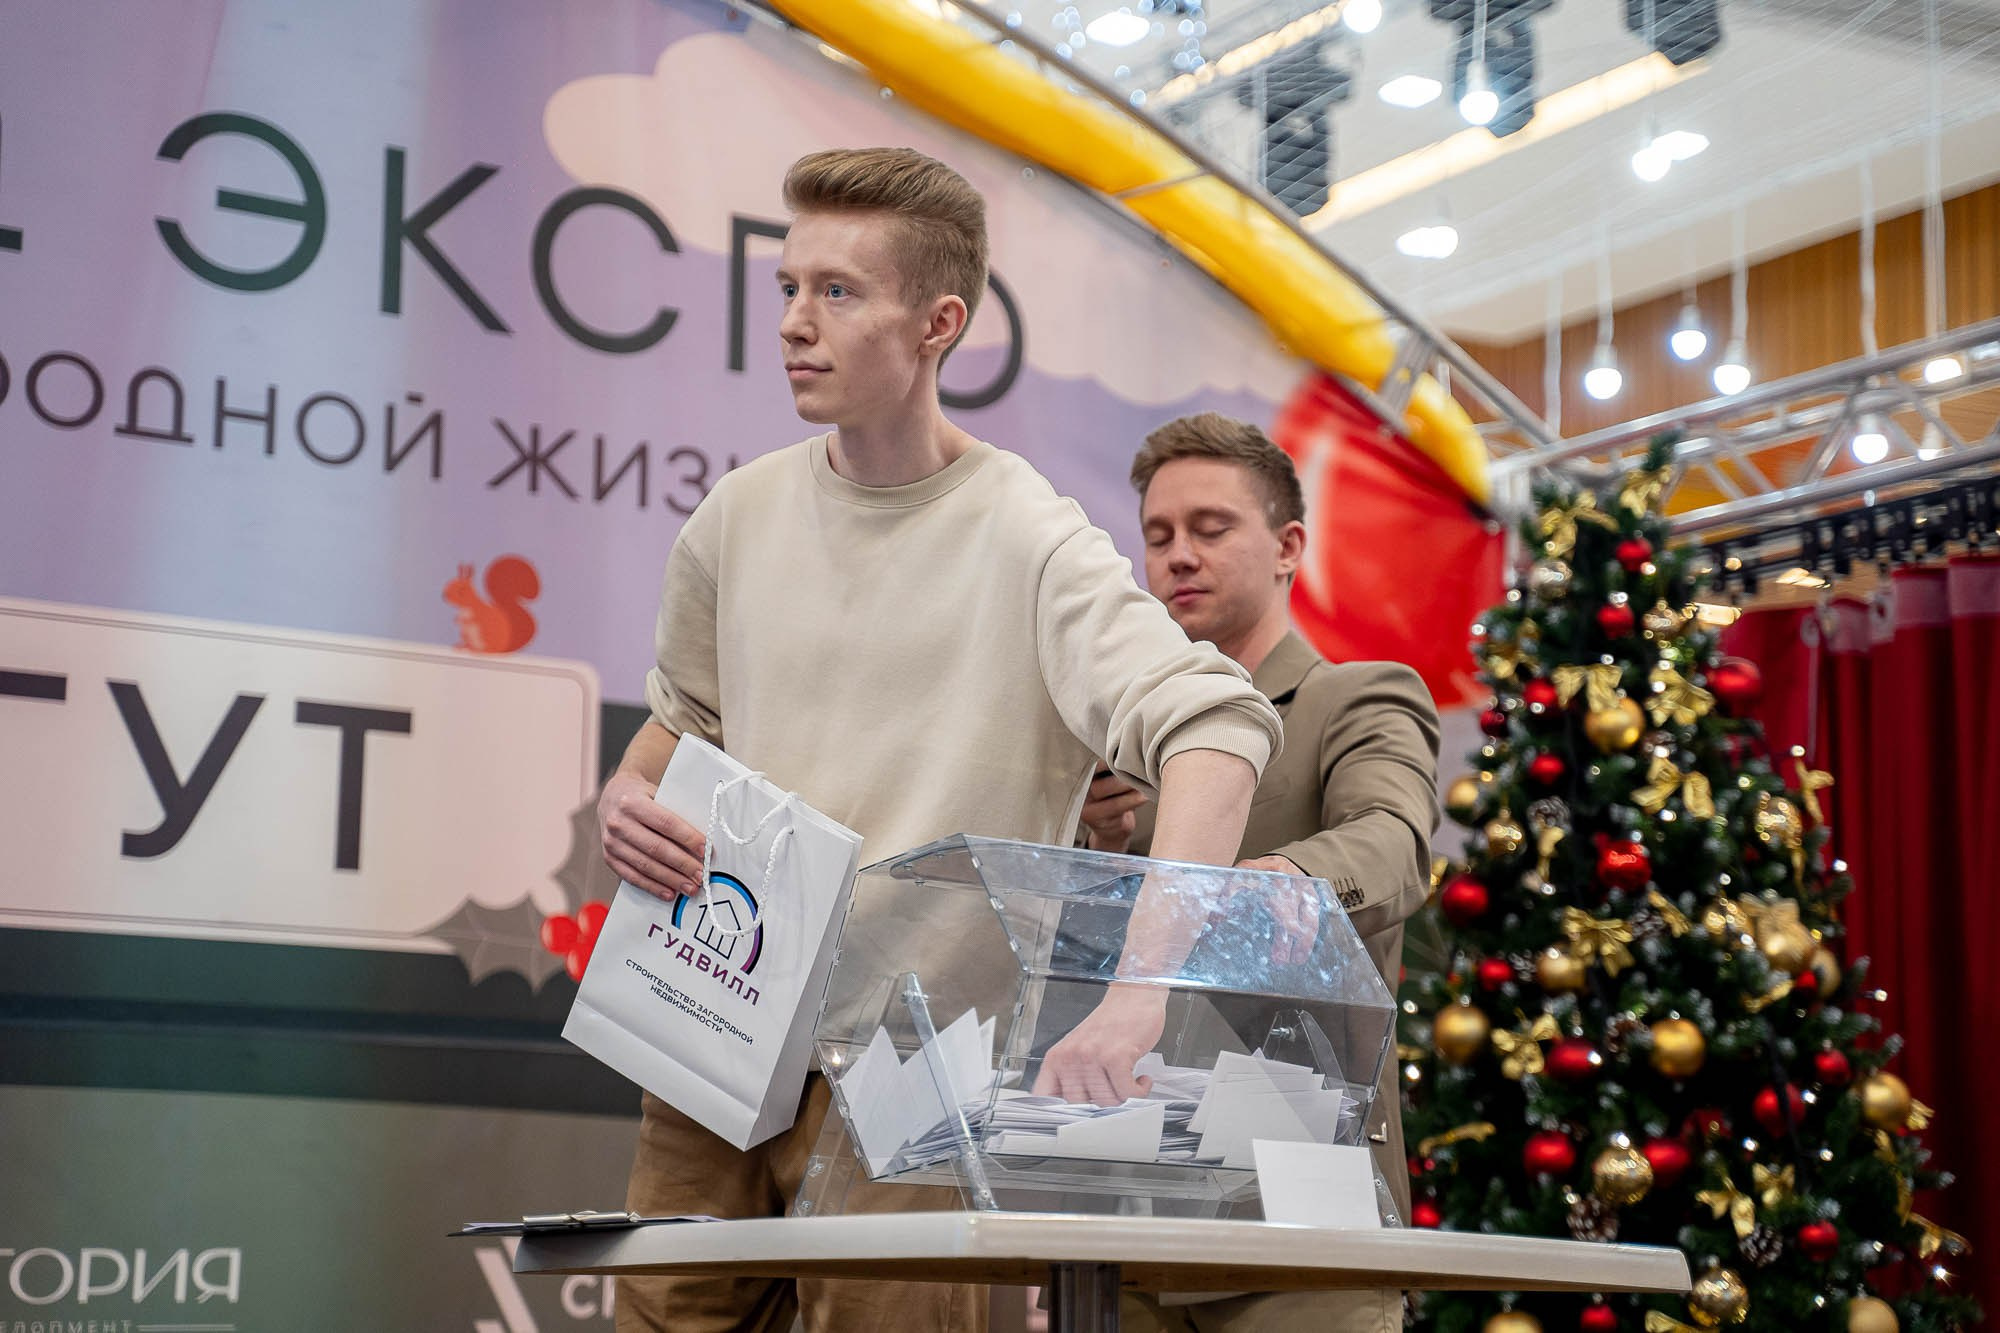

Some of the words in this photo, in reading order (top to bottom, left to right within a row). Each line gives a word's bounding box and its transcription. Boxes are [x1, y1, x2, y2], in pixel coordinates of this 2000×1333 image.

[0, 351, 443, 481] ОДНОЙ
[486, 417, 738, 516] ЖИЗ
[0, 669, 413, 871] УТ
[625, 958, 697, 1008] СТРОИТЕЛЬСТВО
[696, 1003, 754, 1046] ЗАГОРОДНОЙ
[647, 923, 760, 1006] ГУДВИЛЛ
[650, 984, 723, 1035] НЕДВИЖИМОСТИ
[0, 1247, 242, 1305] ОРИЯ
